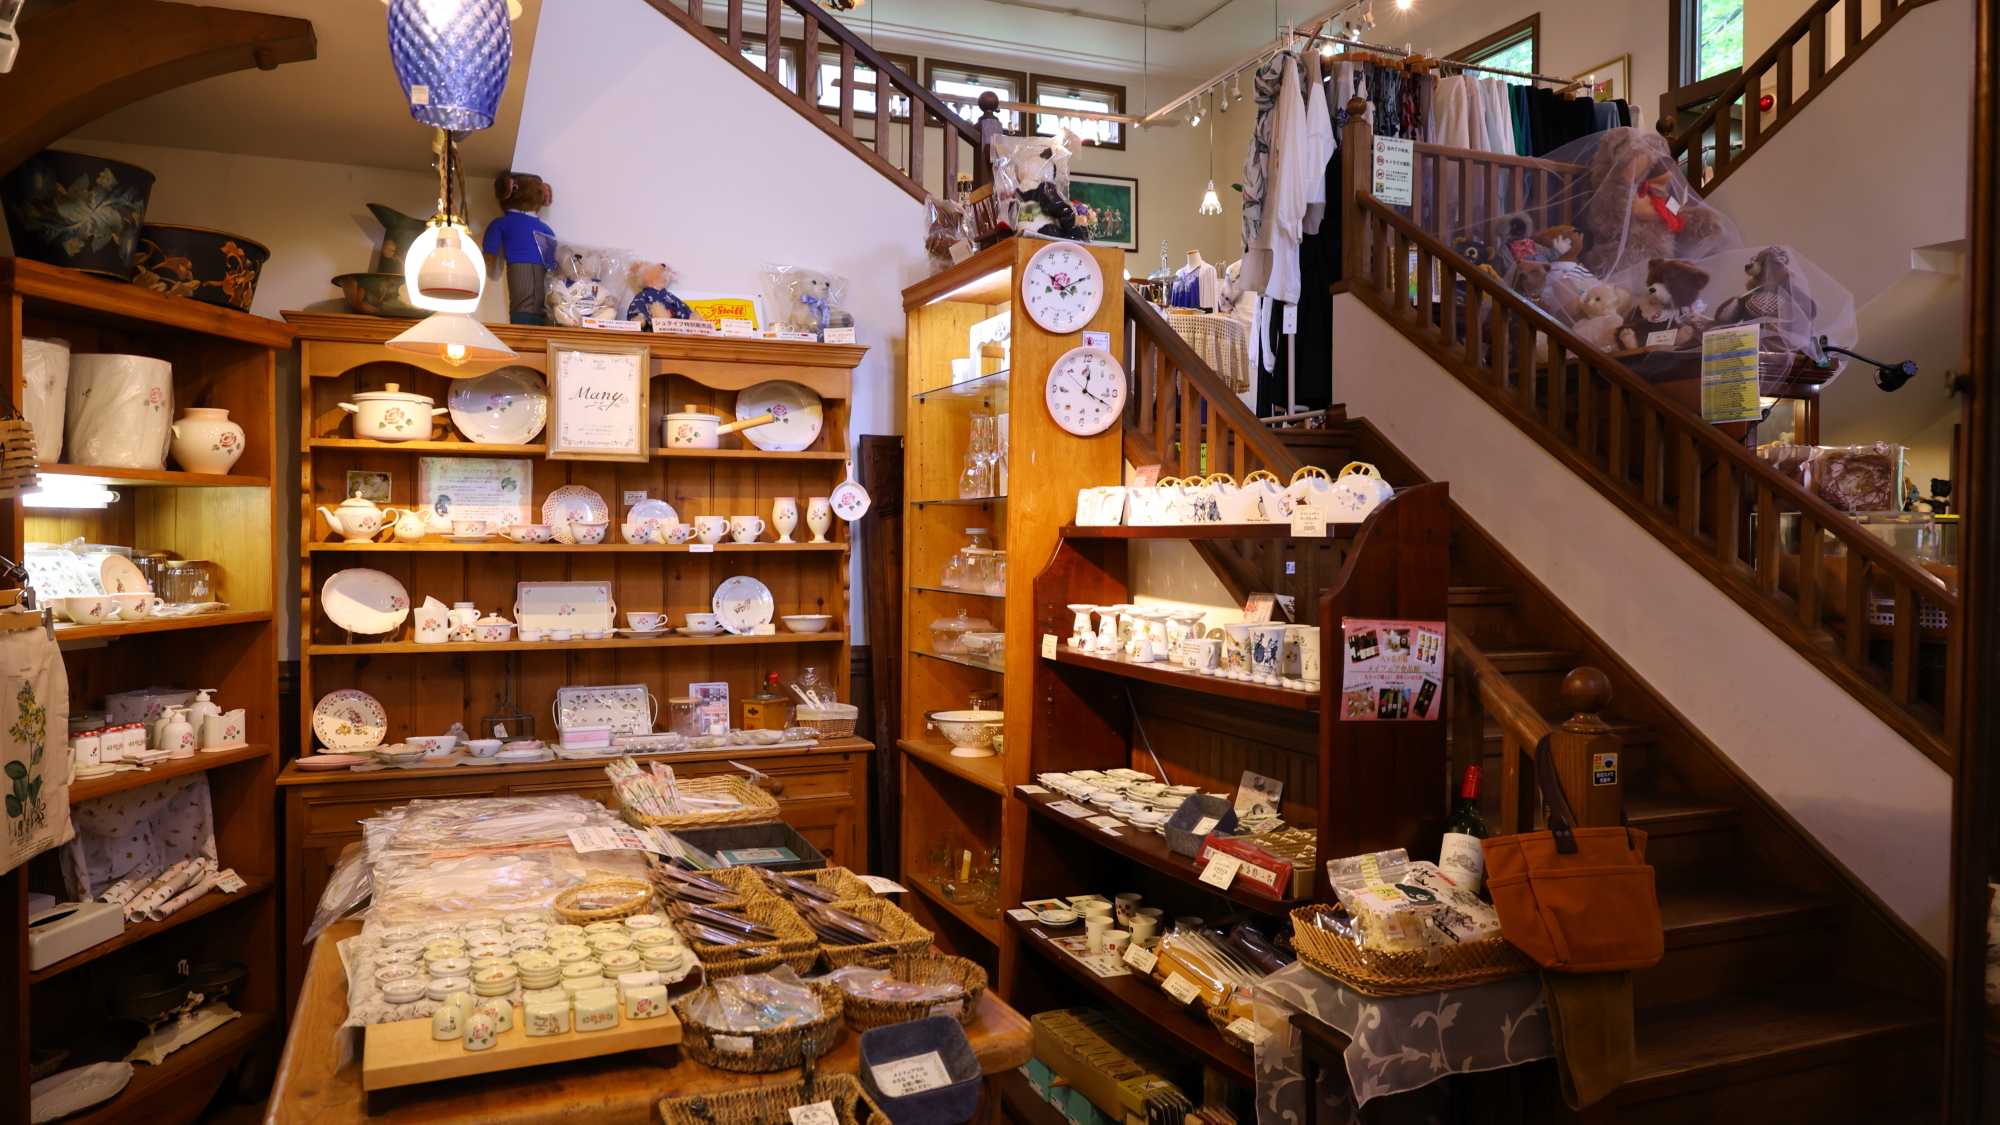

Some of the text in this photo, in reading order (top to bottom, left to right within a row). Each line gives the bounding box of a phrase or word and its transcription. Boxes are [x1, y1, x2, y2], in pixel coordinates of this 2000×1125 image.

[717, 305, 744, 316] Steiff
[654, 320, 713, 329] シュタイフ特別販売品
[1083, 354, 1092, 362] 12
[1053, 384, 1057, 393] 9
[1112, 389, 1118, 398] 3
[568, 386, 623, 412] Many
[1079, 418, 1084, 427] 6
[1367, 665, 1421, 673] メイフェア食品館
[894, 1067, 924, 1078] メイフェアでの
[901, 1082, 932, 1095] ご利用ください
